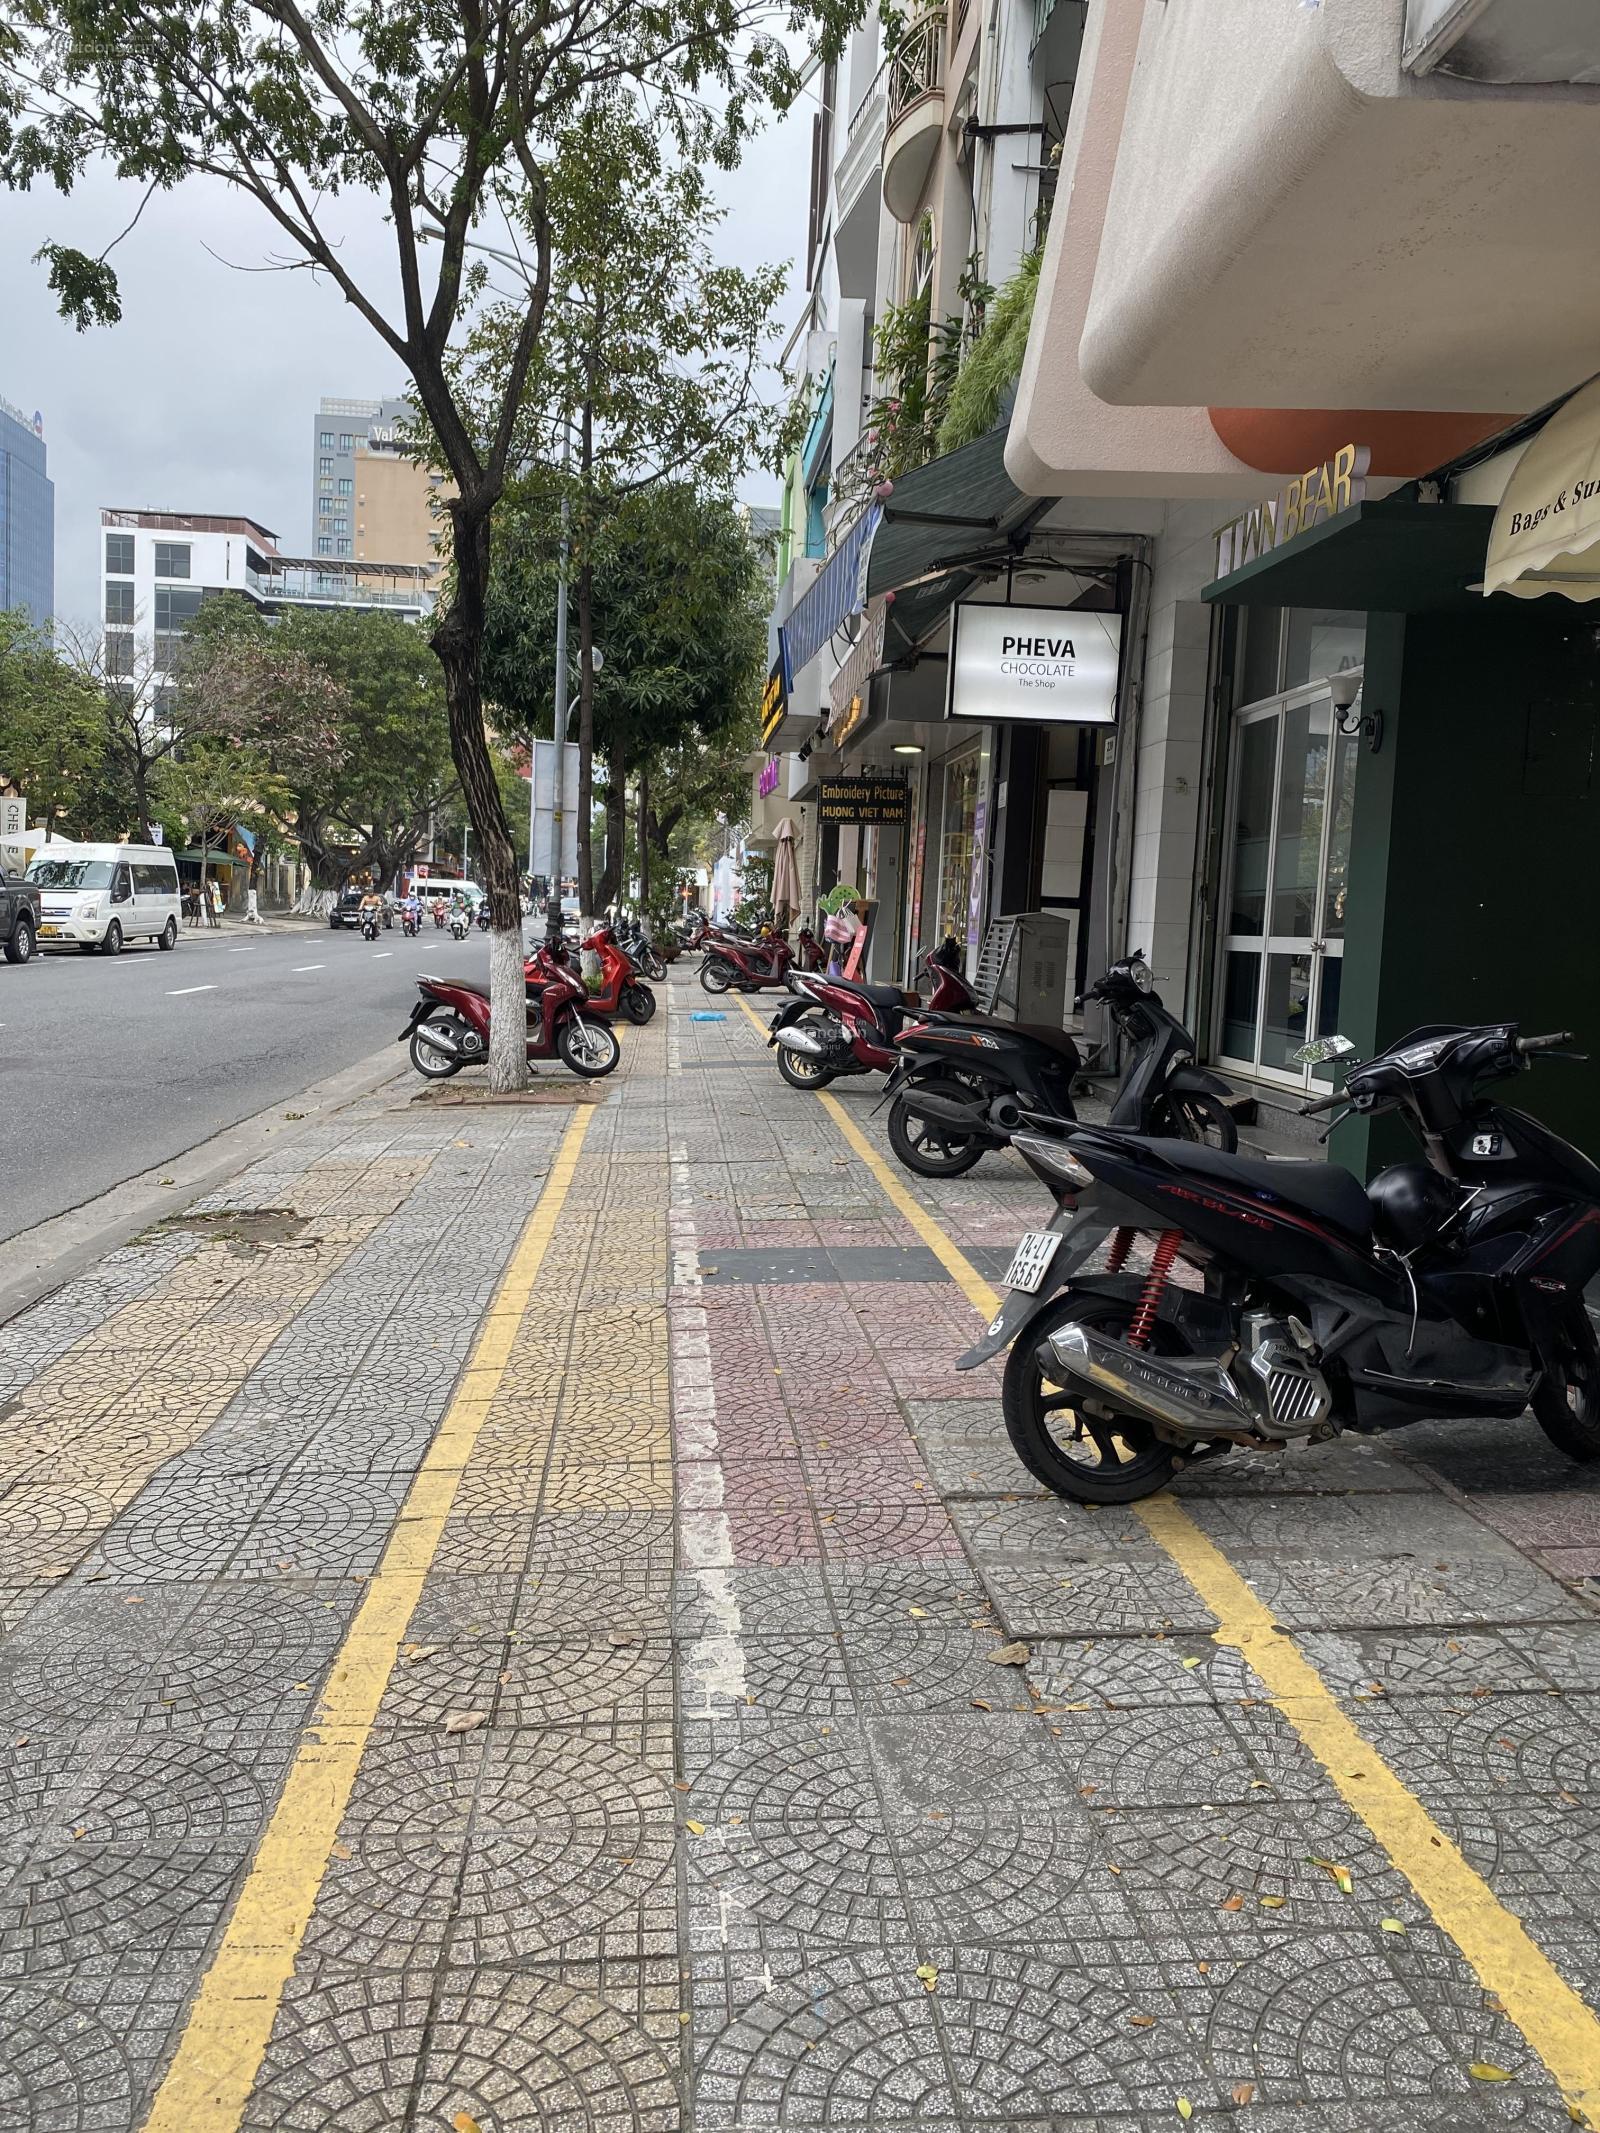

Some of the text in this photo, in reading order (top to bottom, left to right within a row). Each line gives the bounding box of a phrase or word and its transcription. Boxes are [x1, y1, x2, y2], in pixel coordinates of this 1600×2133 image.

[1283, 443, 1357, 543] BEAR
[1509, 504, 1551, 537] Bags
[1553, 490, 1568, 514] &
[1002, 636, 1076, 658] PHEVA
[1000, 661, 1076, 677] CHOCOLATE
[1018, 678, 1056, 690] The Shop
[822, 784, 904, 803] Embroidery Picture
[858, 807, 879, 818] VIET
[882, 808, 903, 818] NAM
[7, 803, 20, 854] CHEE
[1005, 1260, 1045, 1289] 165.61
